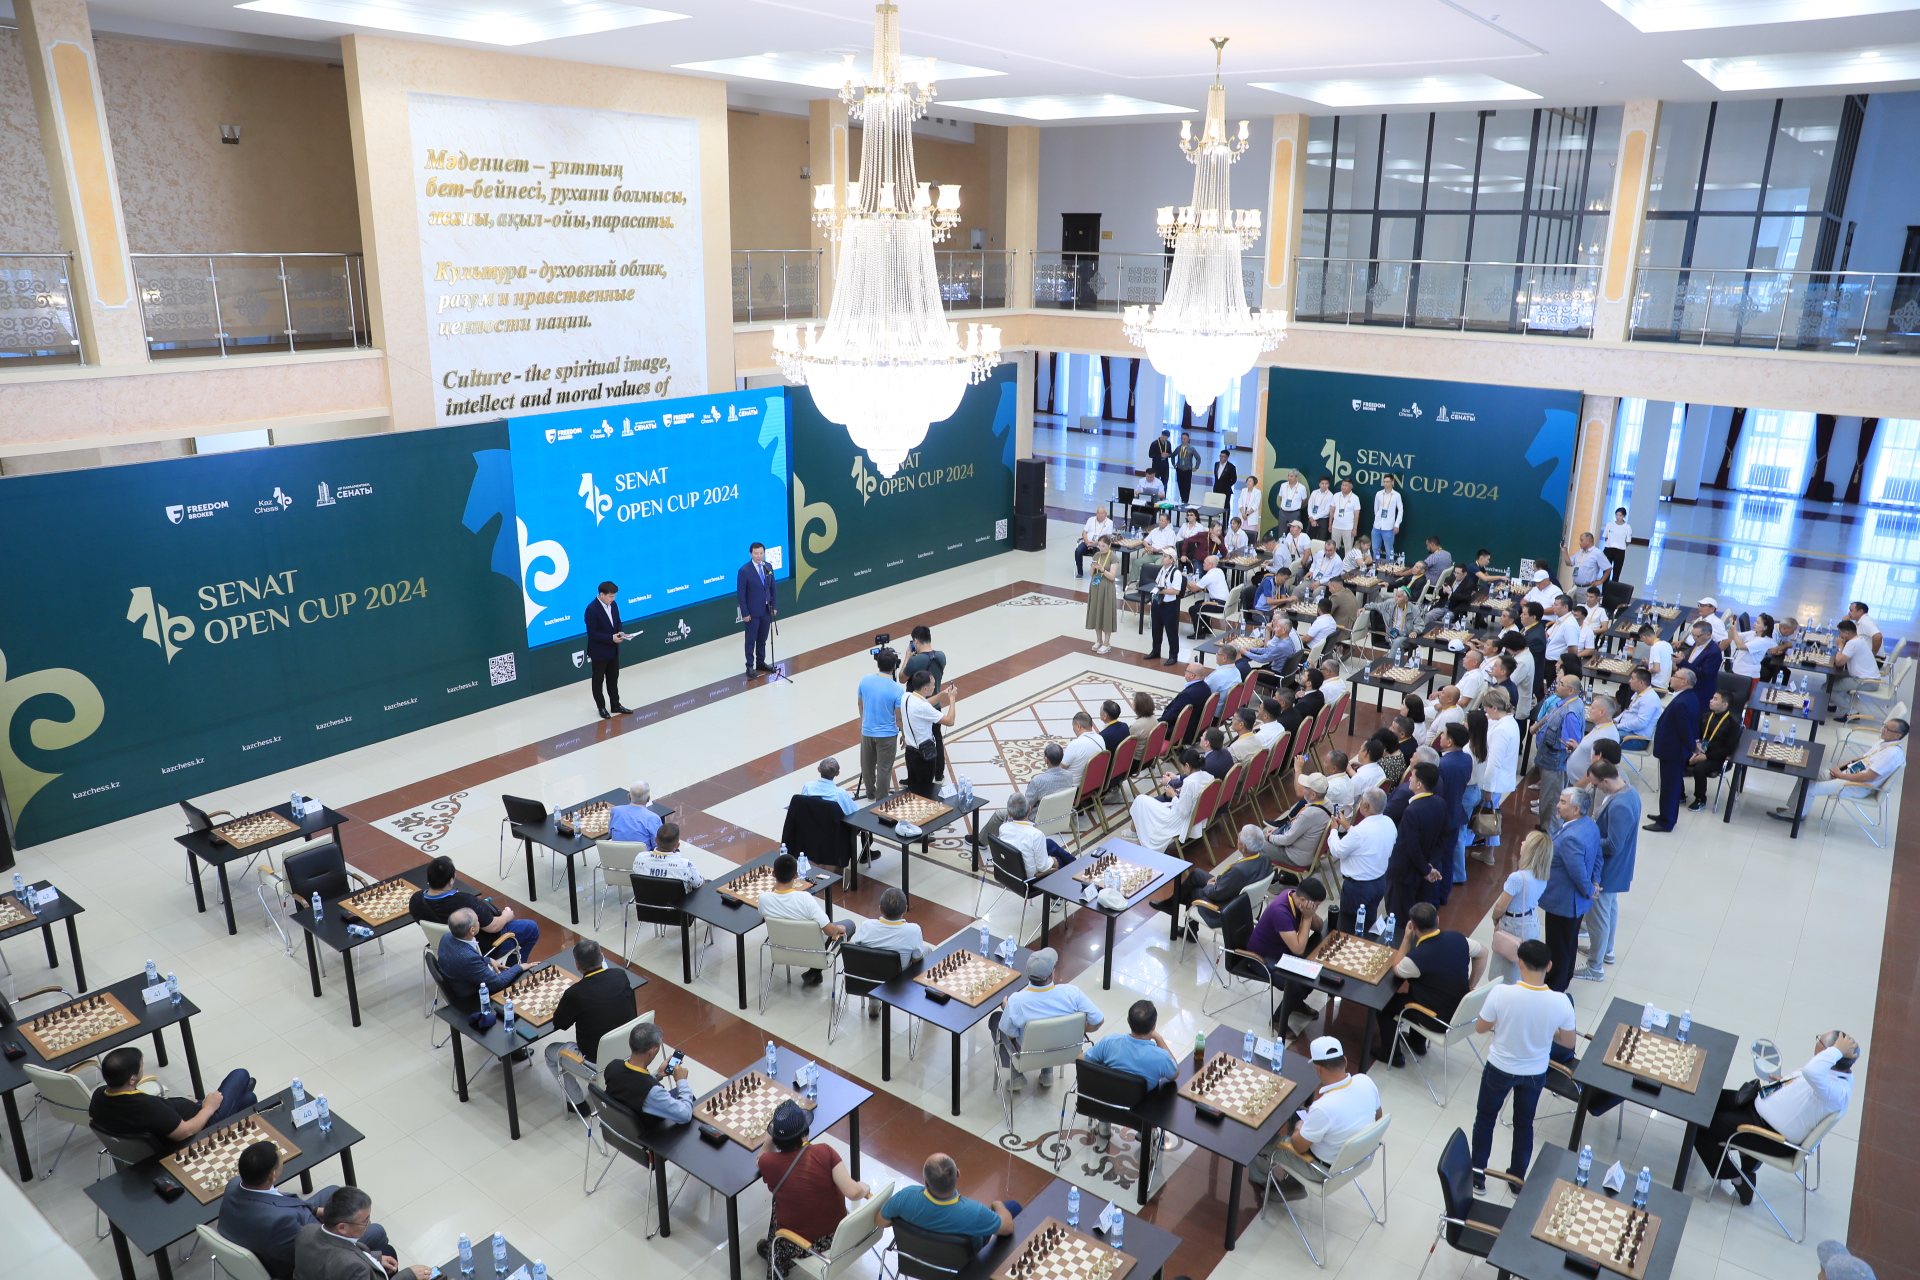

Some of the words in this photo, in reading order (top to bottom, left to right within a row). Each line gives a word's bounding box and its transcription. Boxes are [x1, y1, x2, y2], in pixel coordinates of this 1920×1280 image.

[424, 149, 529, 173] Мәдениет
[549, 161, 623, 181] ұлттың
[426, 176, 547, 203] бет-бейнесі,
[548, 186, 609, 205] рухани
[612, 184, 687, 205] болмысы,
[592, 214, 674, 233] парасаты.
[434, 261, 527, 286] Культура
[539, 259, 617, 283] духовный
[619, 259, 667, 280] облик,
[436, 292, 495, 314] разум
[498, 292, 509, 306] и
[513, 288, 636, 310] нравственные
[438, 318, 531, 340] ценности
[535, 315, 592, 333] нации.
[442, 368, 511, 389] Culture
[524, 364, 551, 382] the
[554, 356, 621, 384] spiritual
[623, 355, 671, 374] image,
[445, 392, 516, 416] intellect
[519, 387, 552, 408] and
[555, 383, 602, 404] moral
[605, 380, 651, 400] values
[654, 375, 672, 398] of
[1356, 448, 1416, 469] SENAT
[615, 467, 668, 492] SENAT
[880, 475, 915, 497] OPEN
[918, 470, 944, 488] CUP
[946, 463, 974, 482] 2024
[1409, 475, 1449, 494] CUP
[1452, 480, 1499, 501] 2024
[258, 499, 273, 507] Kaz
[336, 487, 372, 498] СЕНАТЫ
[617, 498, 663, 522] OPEN
[667, 491, 700, 512] CUP
[703, 484, 739, 505] 2024
[187, 500, 229, 513] FREEDOM
[188, 510, 214, 520] BROKER
[254, 505, 279, 514] Chess
[197, 569, 298, 611] SENAT
[204, 605, 290, 644] OPEN
[298, 592, 357, 624] CUP
[363, 576, 428, 610] 2024
[383, 697, 418, 711] kazchess.kz
[315, 715, 353, 730] kazchess.kz
[241, 735, 282, 751] kazchess.kz
[161, 756, 205, 775] kazchess.kz
[72, 780, 121, 799] kazchess.kz
